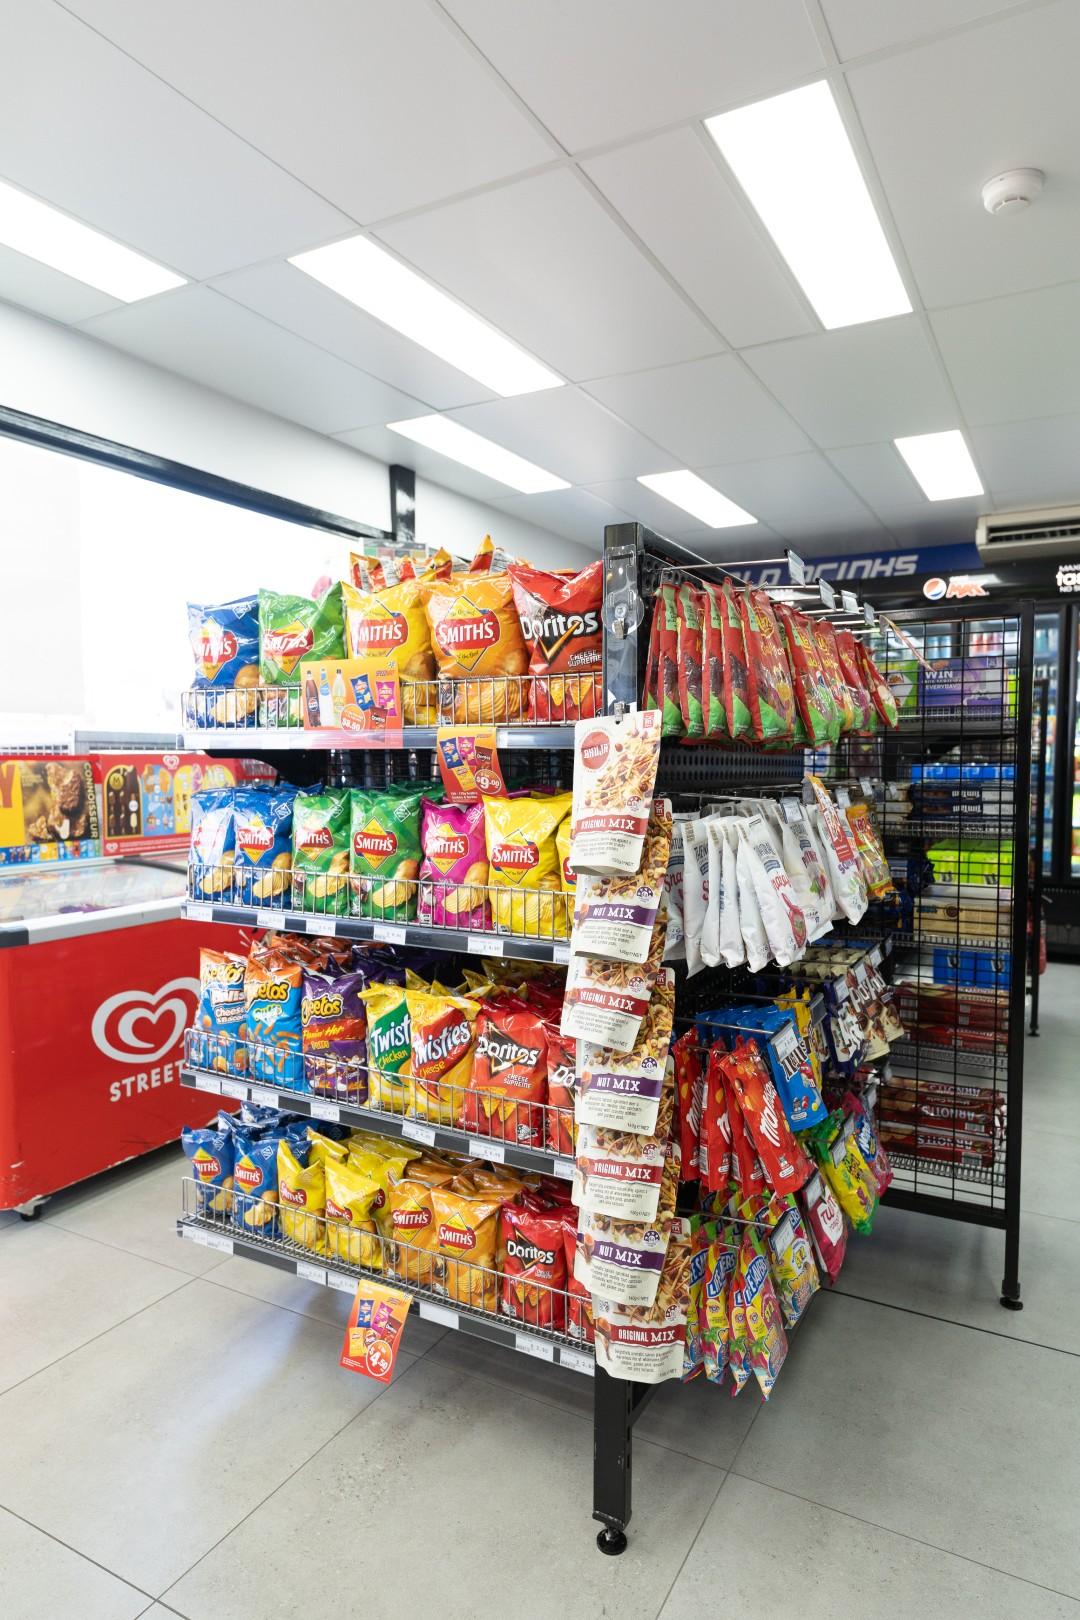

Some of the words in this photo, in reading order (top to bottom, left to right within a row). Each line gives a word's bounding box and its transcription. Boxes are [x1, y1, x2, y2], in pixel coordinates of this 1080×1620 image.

[355, 621, 403, 644] MITH'S
[438, 618, 494, 645] SMITH'S
[520, 611, 599, 640] Doritos
[567, 655, 602, 668] SUPREME
[570, 650, 597, 662] CHEESE
[925, 670, 953, 679] WIN
[583, 743, 609, 760] BHUJA
[84, 762, 99, 839] CONNOISSEUR
[608, 819, 635, 831] MIX
[356, 835, 394, 854] SMITH'S
[426, 838, 465, 855] SMITH'S
[492, 846, 535, 864] SMITH'S
[608, 907, 635, 920] MIX
[608, 996, 635, 1011] MIX
[412, 1021, 471, 1068] Twisties
[478, 1036, 540, 1067] Doritos
[507, 1073, 530, 1084] CHEESE
[597, 1077, 611, 1088] NUT
[613, 1079, 641, 1092] MIX
[235, 1166, 260, 1183] SMITH'S
[625, 1166, 652, 1180] MIX
[393, 1212, 429, 1224] SMITH'S
[439, 1228, 473, 1247] SMITH'S
[507, 1240, 554, 1265] Doritos
[598, 1244, 614, 1258] NUT
[615, 1248, 643, 1265] MIX
[618, 1329, 649, 1342] ORIGINAL
[650, 1330, 676, 1342] MIX
